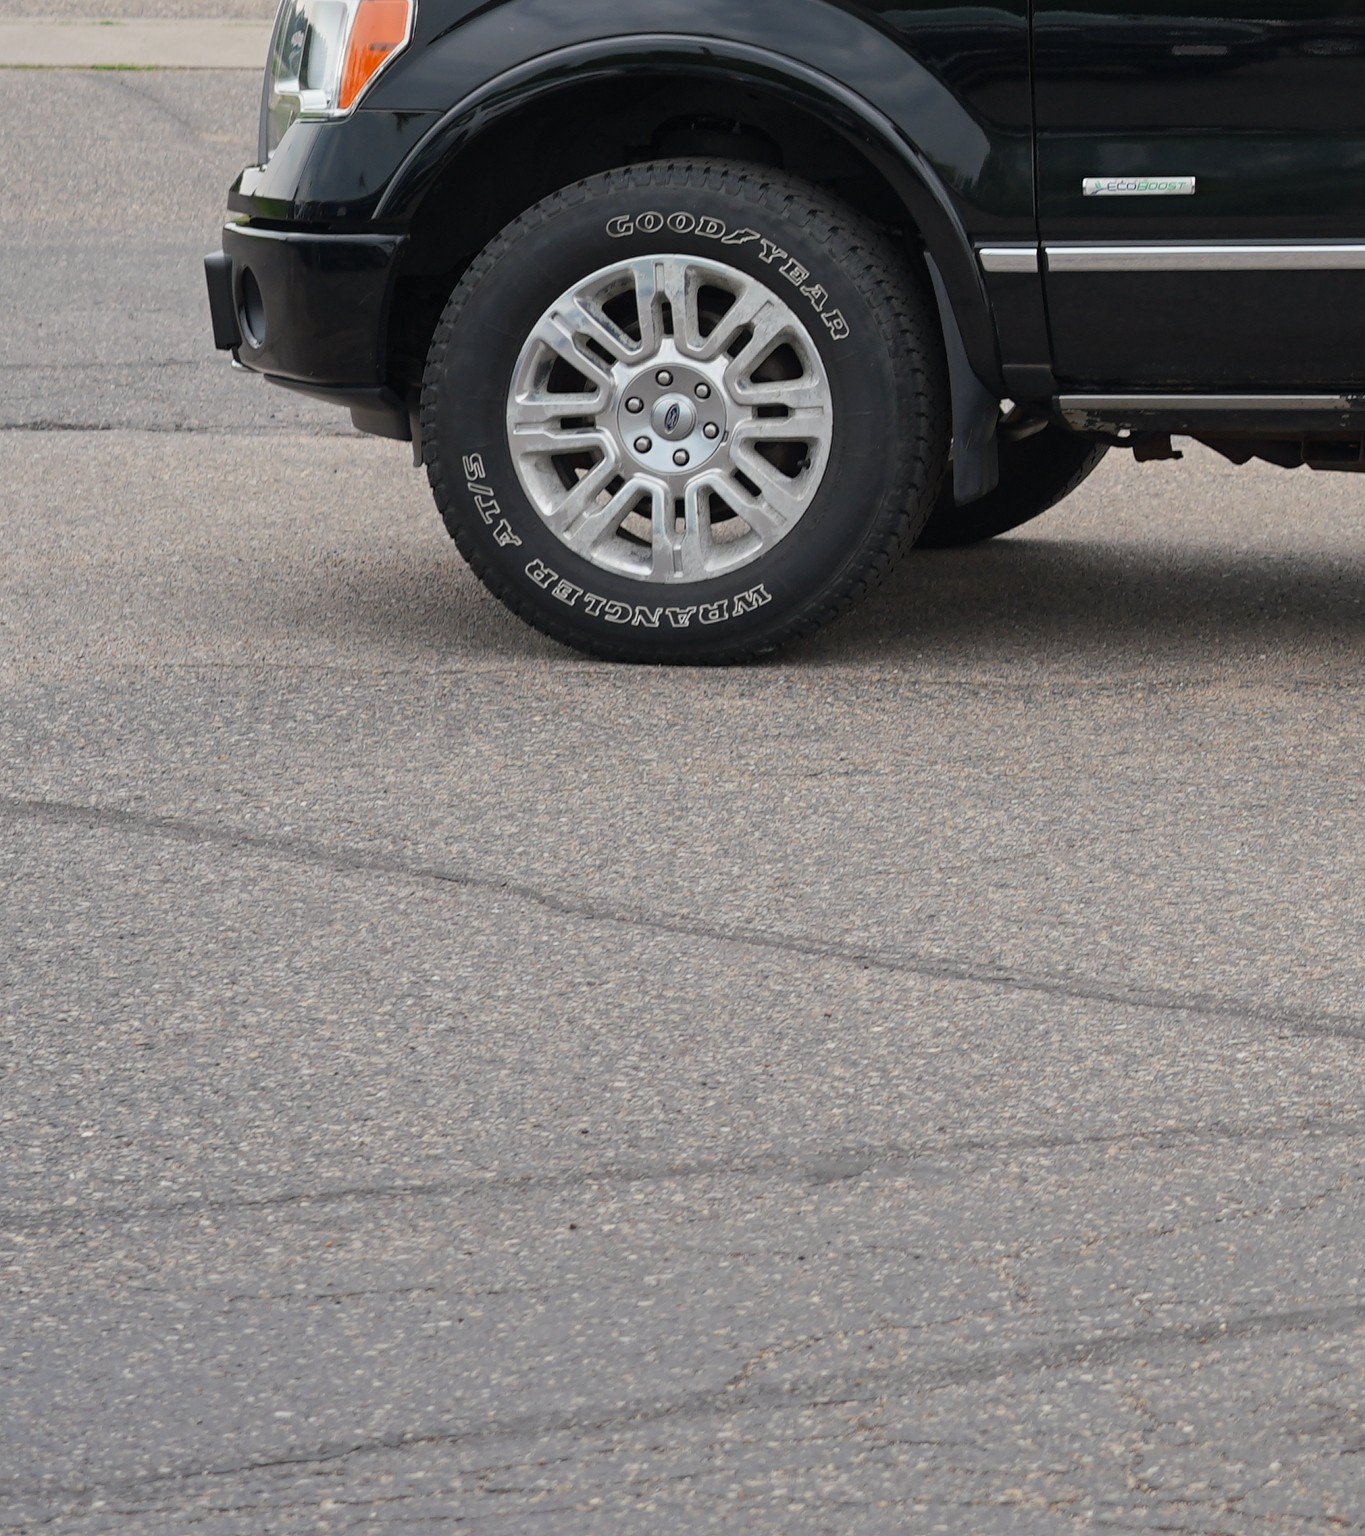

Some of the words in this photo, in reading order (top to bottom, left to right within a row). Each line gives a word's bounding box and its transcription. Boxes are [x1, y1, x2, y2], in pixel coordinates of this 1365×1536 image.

[605, 210, 851, 341] GOODYEAR
[462, 452, 522, 550] AT/S
[524, 559, 773, 627] WRANGLER
